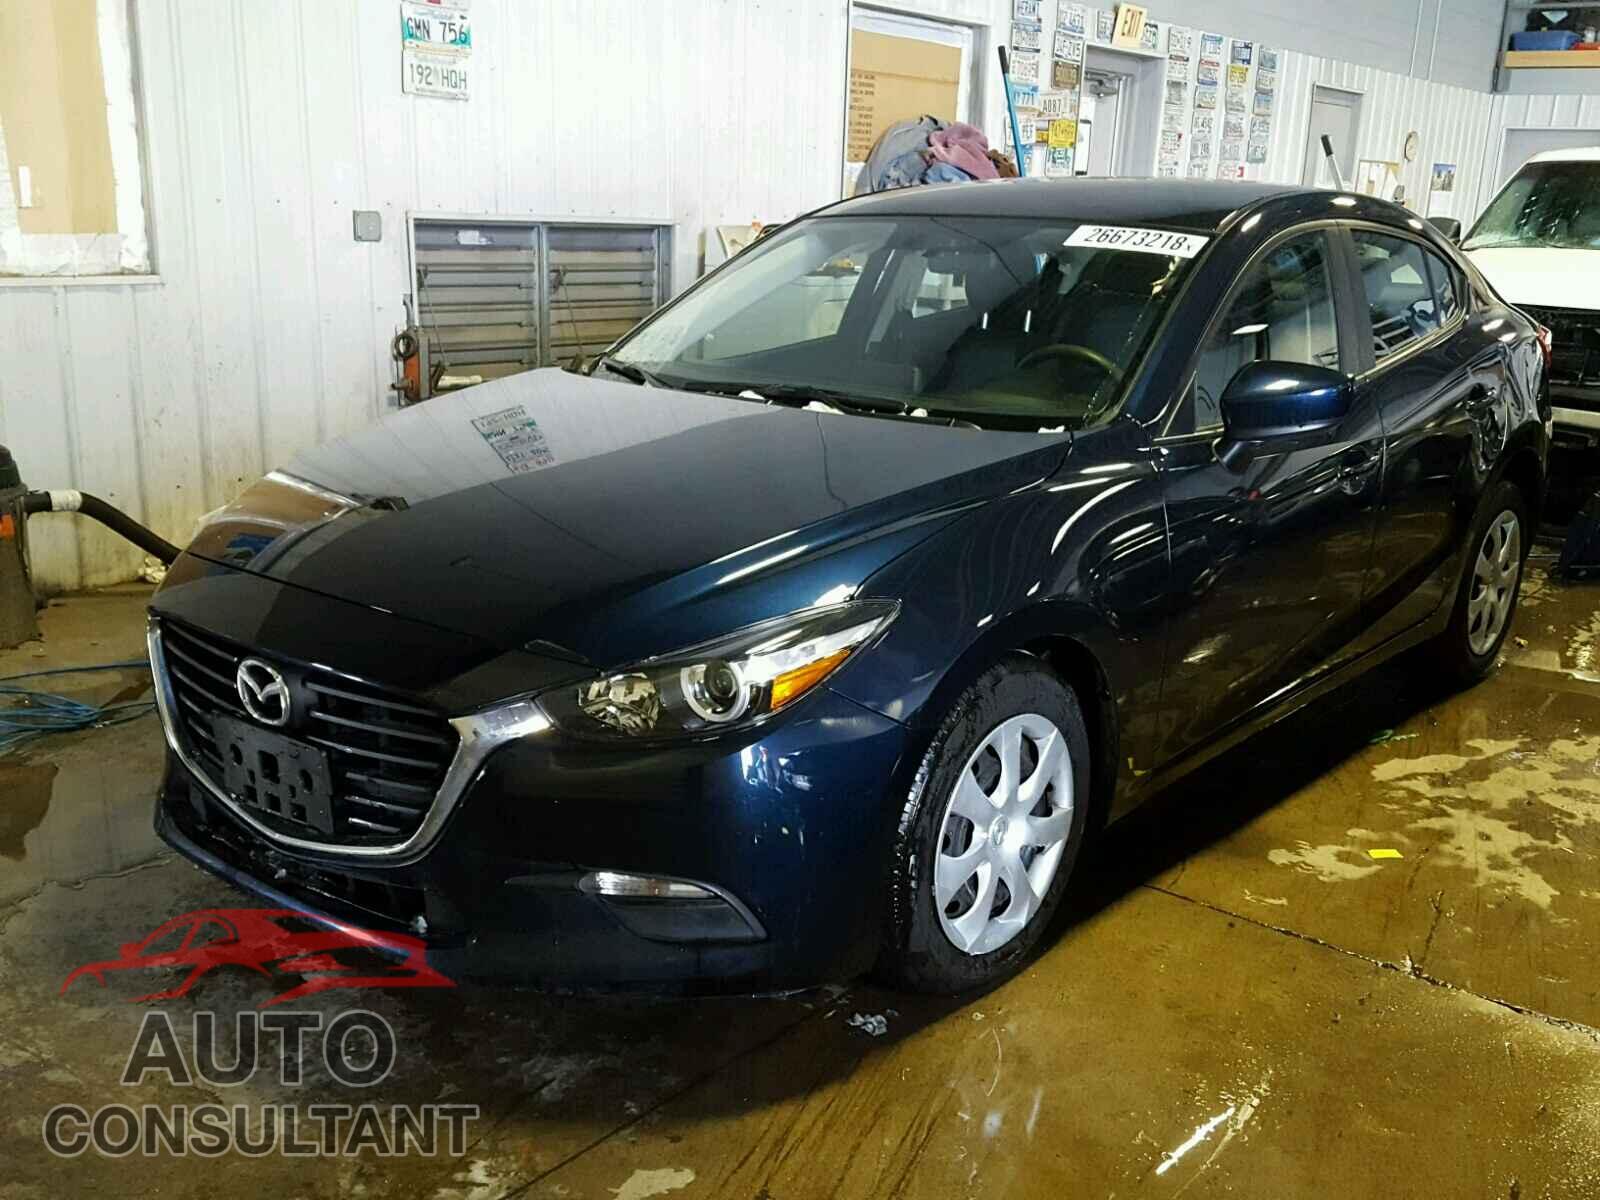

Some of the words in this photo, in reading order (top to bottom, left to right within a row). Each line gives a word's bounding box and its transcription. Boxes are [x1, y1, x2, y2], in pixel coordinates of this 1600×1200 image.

[407, 16, 431, 40] GMN
[439, 21, 468, 44] 756
[410, 63, 433, 86] 192
[441, 69, 468, 90] HQH
[1084, 228, 1188, 251] 26673218
